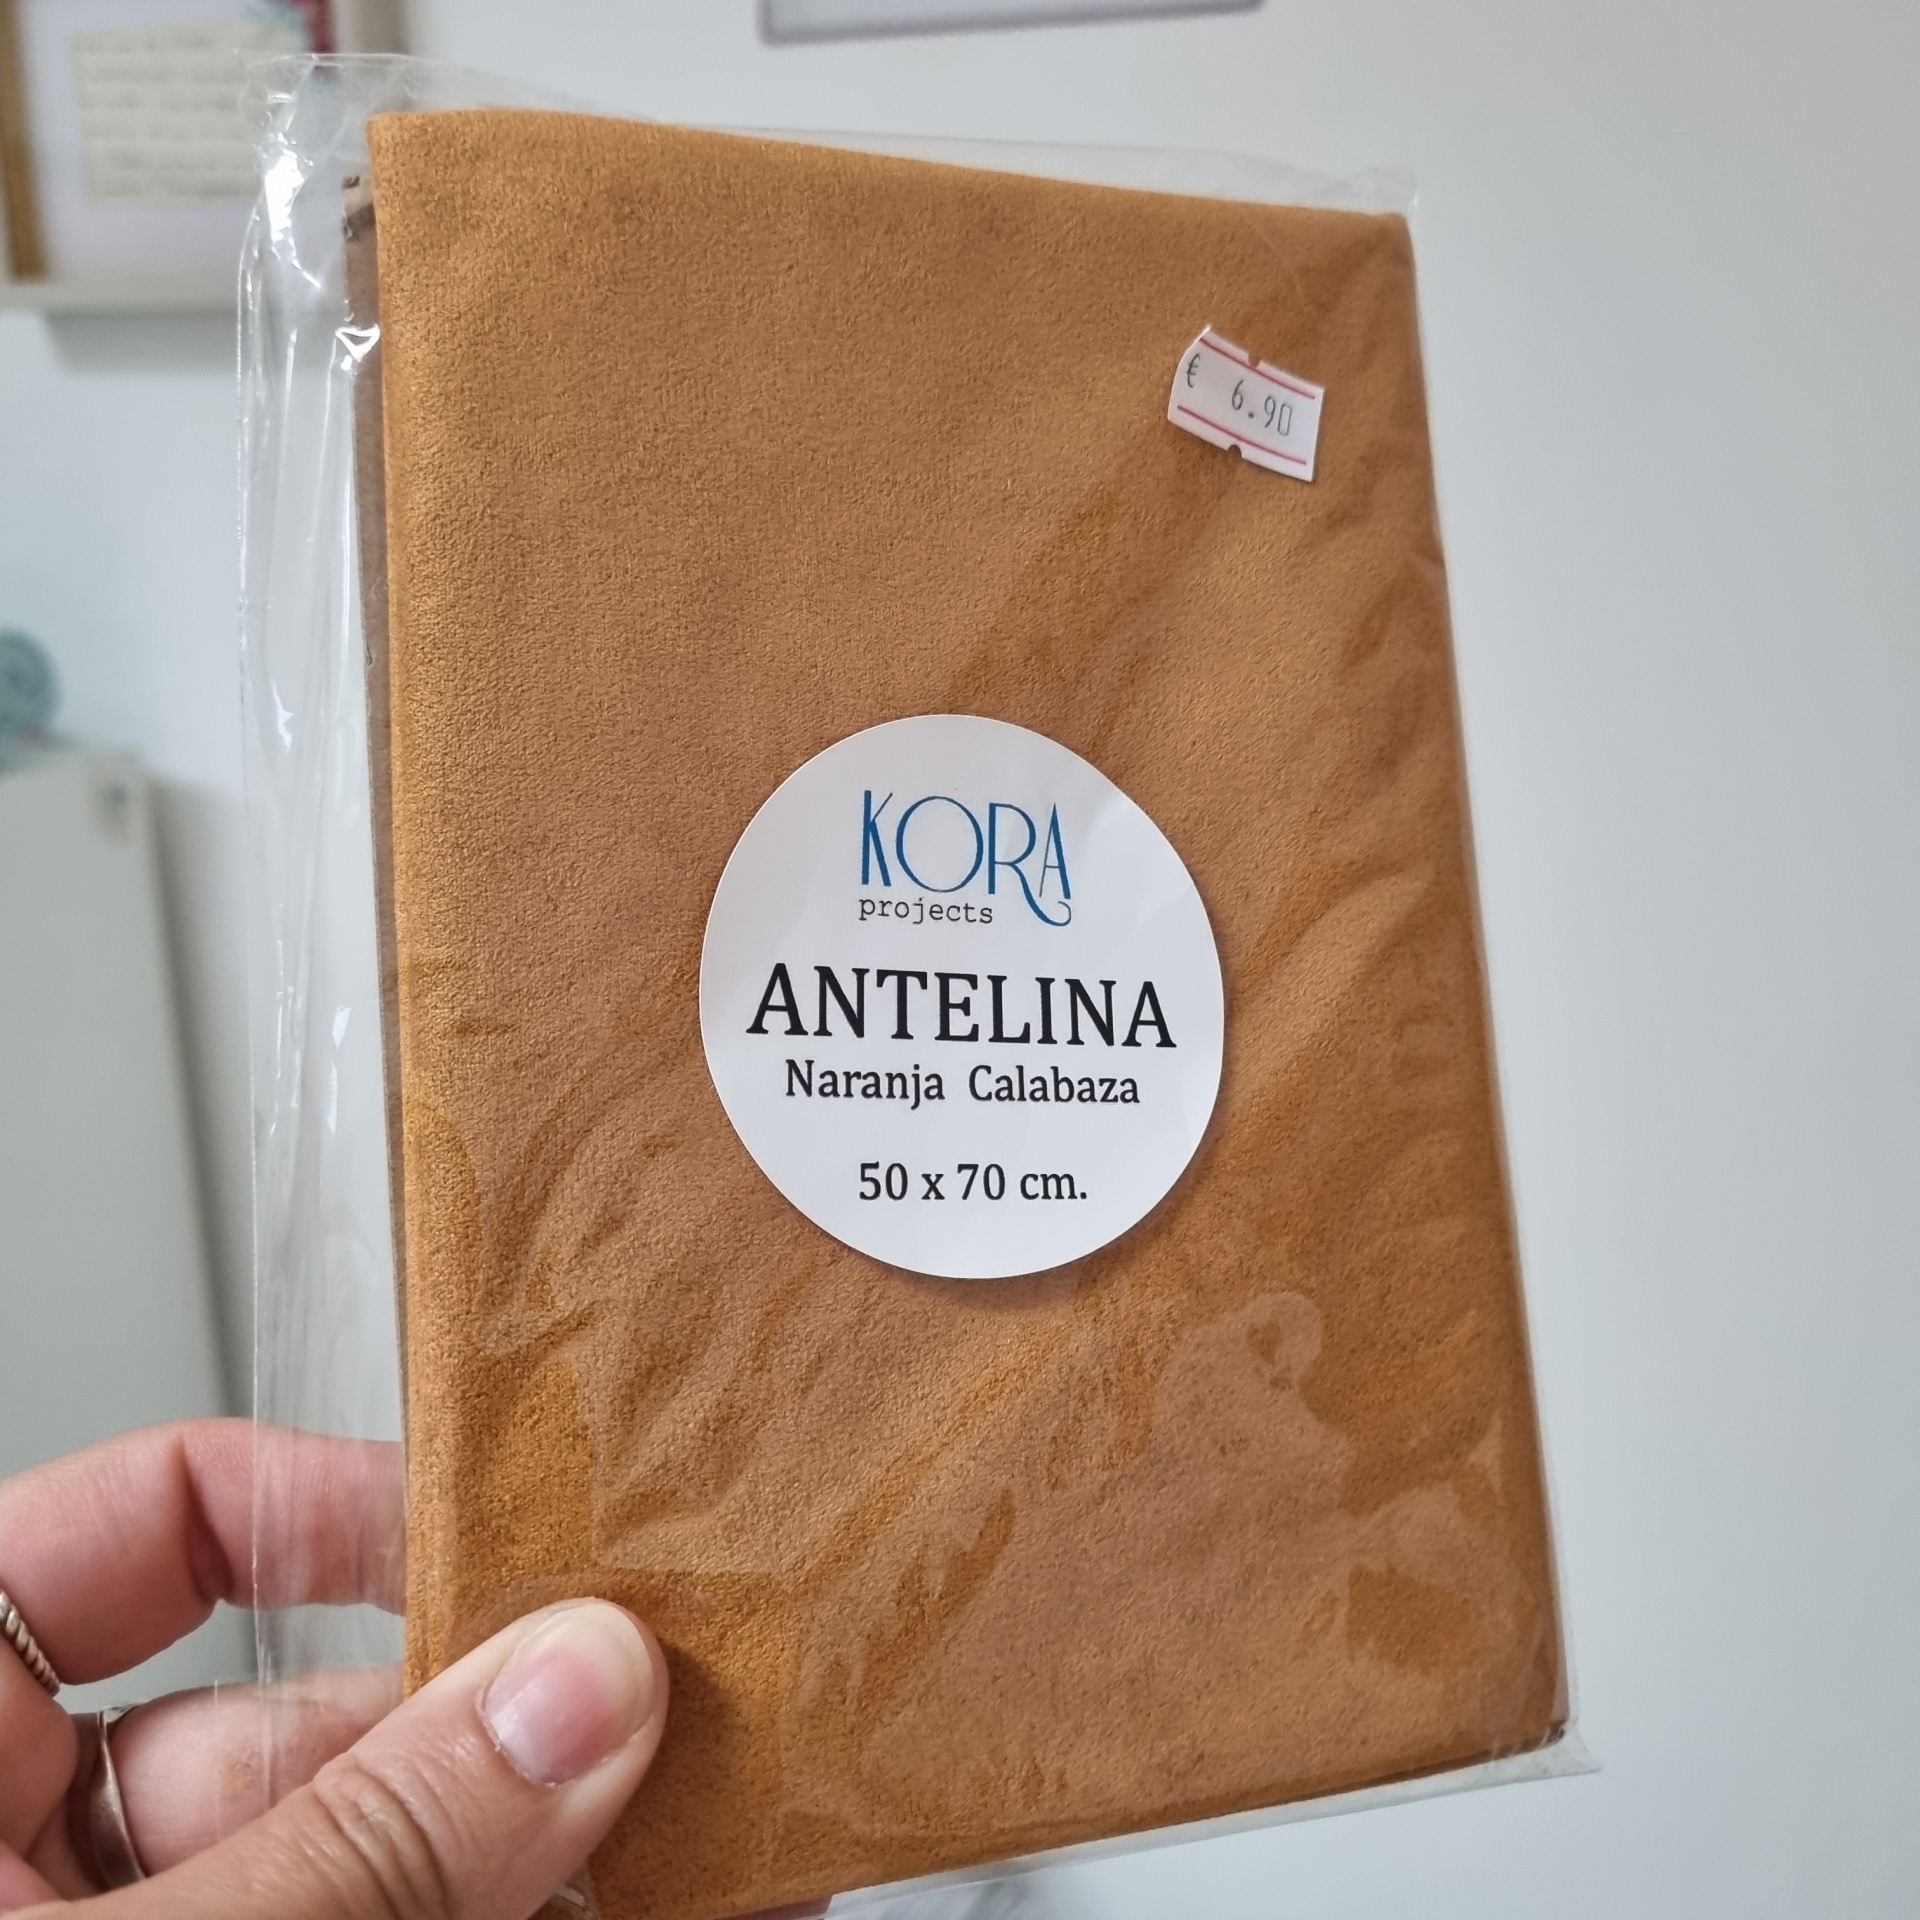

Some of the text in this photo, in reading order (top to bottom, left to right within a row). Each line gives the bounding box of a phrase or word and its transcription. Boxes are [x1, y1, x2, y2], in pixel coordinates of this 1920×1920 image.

[1186, 353, 1293, 437] € 6.90
[861, 789, 1073, 927] KORA
[858, 896, 994, 925] projects
[746, 962, 1177, 1048] ANTELINA
[785, 1058, 1140, 1110] Naranja Calabaza
[858, 1161, 1088, 1201] 50 x 70 cm.
